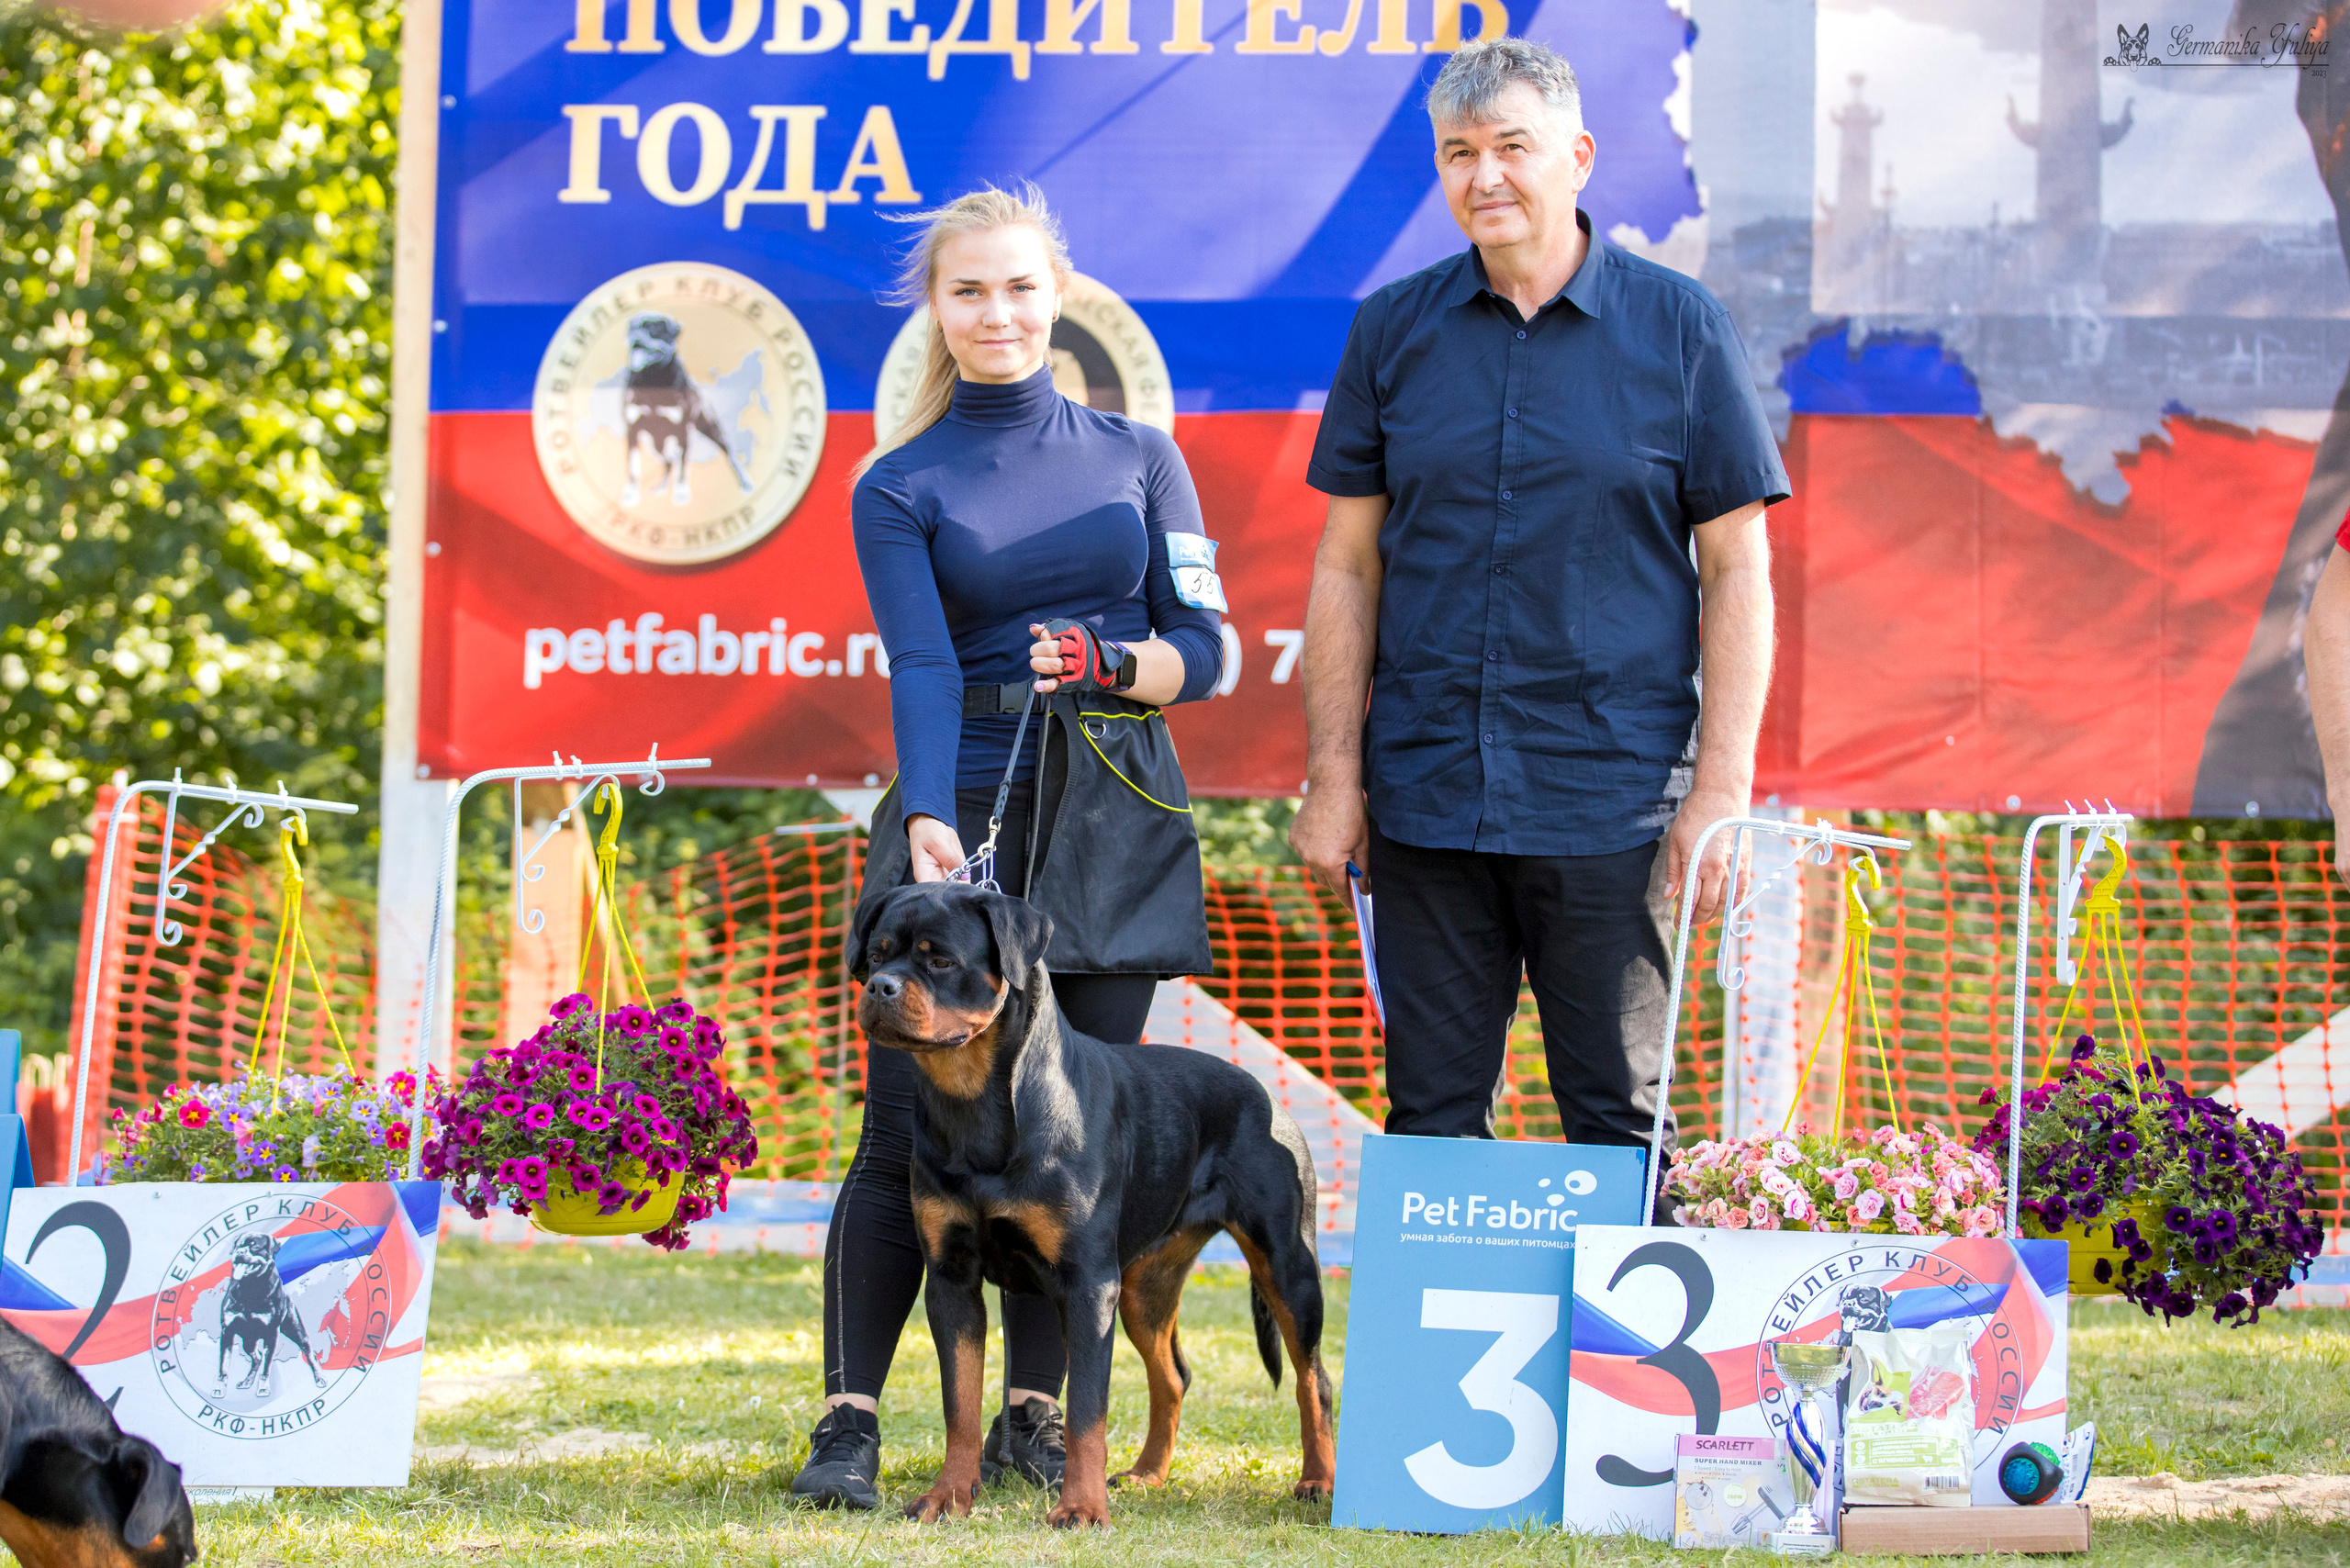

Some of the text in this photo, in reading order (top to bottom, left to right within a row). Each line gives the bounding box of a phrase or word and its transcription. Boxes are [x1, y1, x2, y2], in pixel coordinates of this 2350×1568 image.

[557, 101, 923, 231] ГОДА
[546, 276, 816, 478] РОТВЕЙЛЕР КЛУБ РОССИИ
[156, 1199, 388, 1374] РОТВЕЙЛЕР КЛУБ РОССИИ
[1400, 1232, 1434, 1243] умная
[1436, 1233, 1473, 1244] забота
[1484, 1237, 1520, 1247] ваших
[1522, 1239, 1576, 1249] питомцах
[1402, 1192, 1578, 1232] Pet Fabric
[197, 1398, 328, 1436] РКФ-НКПР
[1404, 1288, 1560, 1509] 3
[1596, 1241, 1721, 1486] 3
[1885, 1250, 1973, 1293] КЛУБ
[1978, 1300, 2020, 1435] РОССИИ
[1695, 1439, 1754, 1450] SCARLETT
